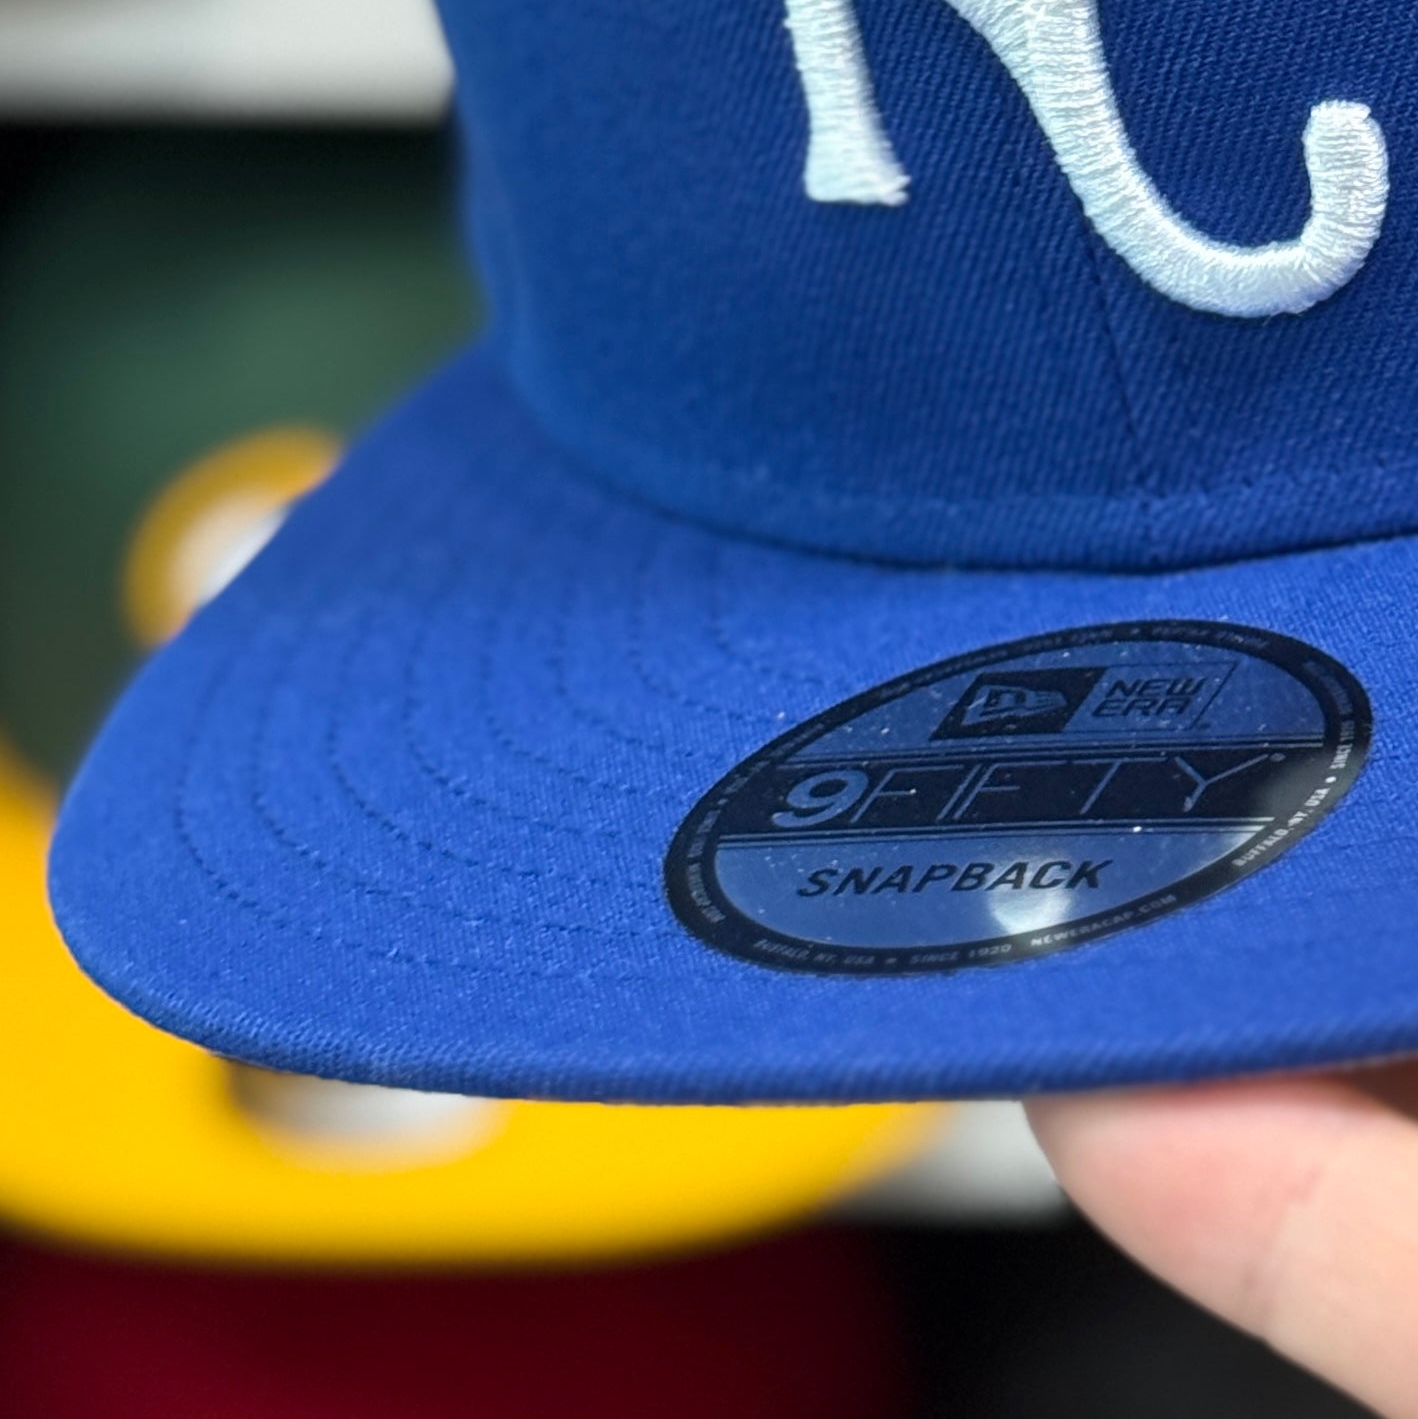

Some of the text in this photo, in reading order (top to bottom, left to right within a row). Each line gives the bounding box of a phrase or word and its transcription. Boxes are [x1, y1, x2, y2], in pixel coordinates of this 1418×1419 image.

[1107, 678, 1206, 697] NEW
[1093, 698, 1192, 717] ERA
[771, 752, 1271, 828] 9FIFTY
[1304, 788, 1330, 807] USA
[798, 859, 1112, 898] SNAPBACK
[967, 943, 1013, 959] 1920
